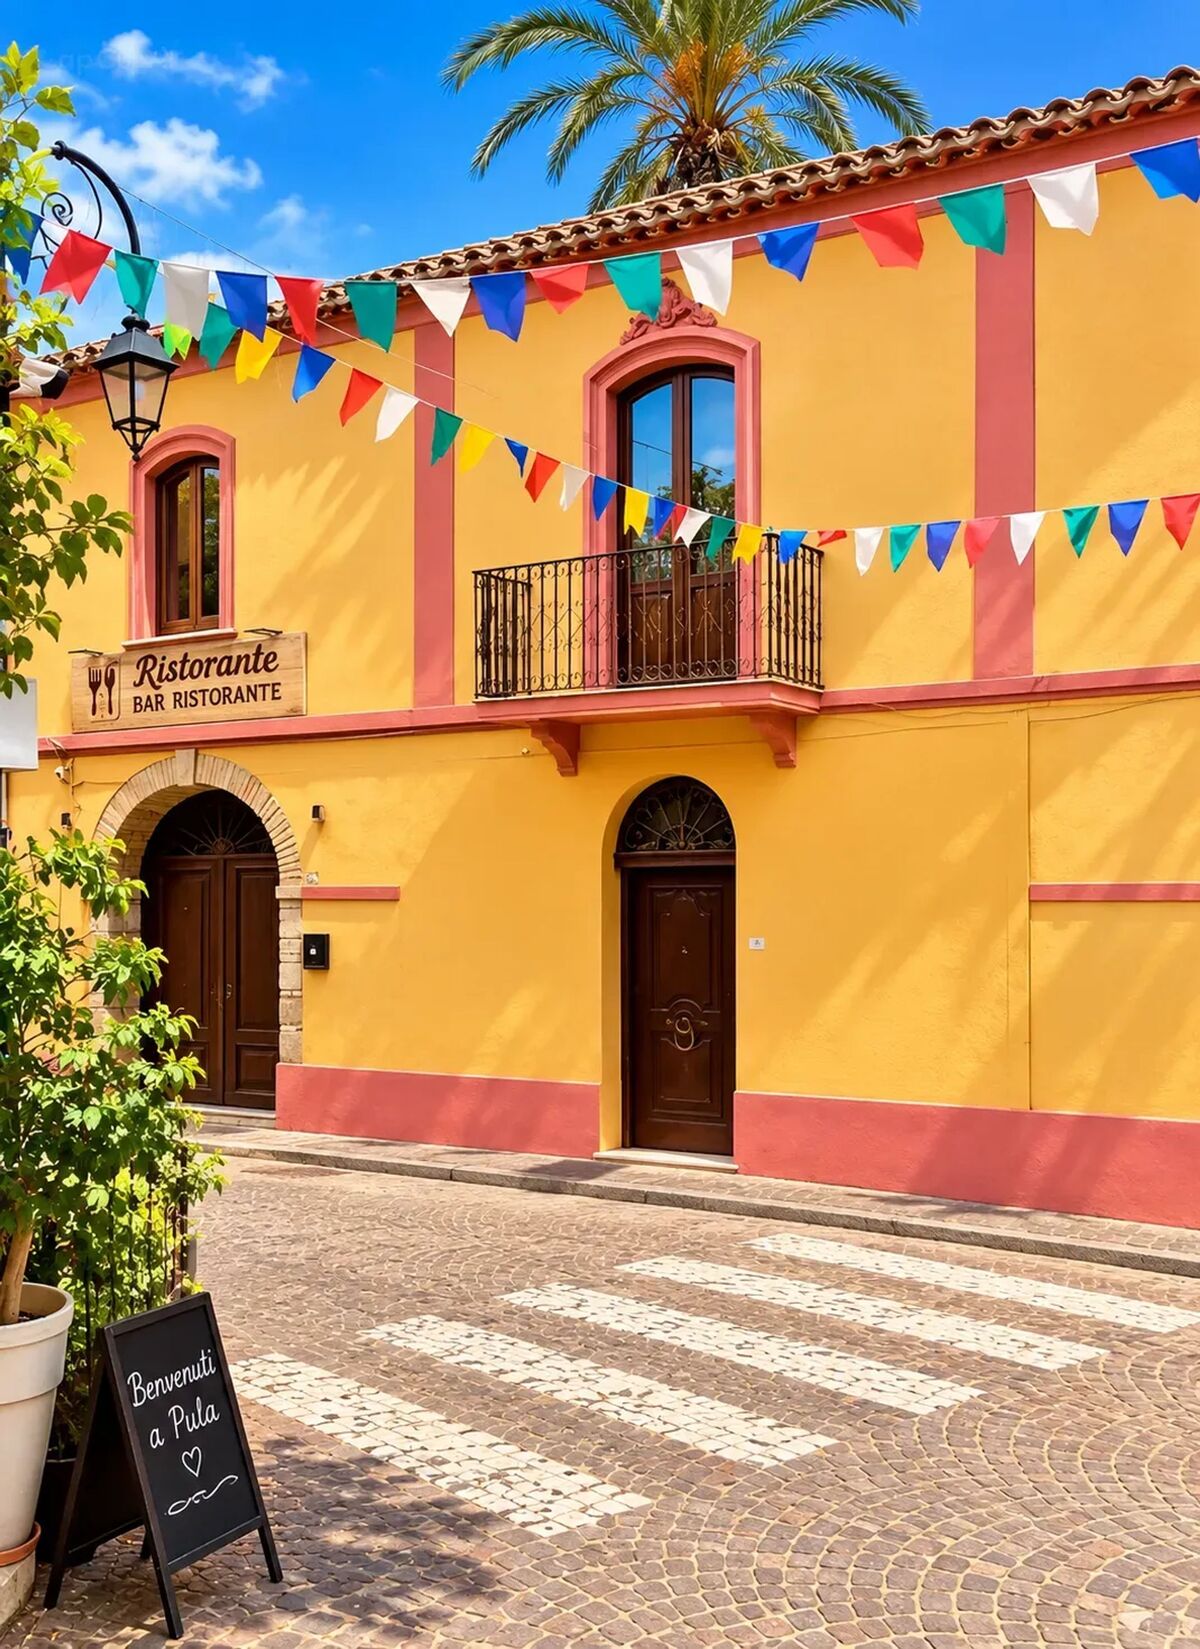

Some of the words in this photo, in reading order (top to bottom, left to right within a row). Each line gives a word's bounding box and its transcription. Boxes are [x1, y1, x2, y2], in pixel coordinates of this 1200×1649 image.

[133, 643, 279, 690] Ristorante
[133, 694, 165, 714] BAR
[173, 682, 282, 709] RISTORANTE
[127, 1349, 216, 1407] Benvenuti
[149, 1427, 164, 1449] a
[168, 1396, 220, 1440] Pula
